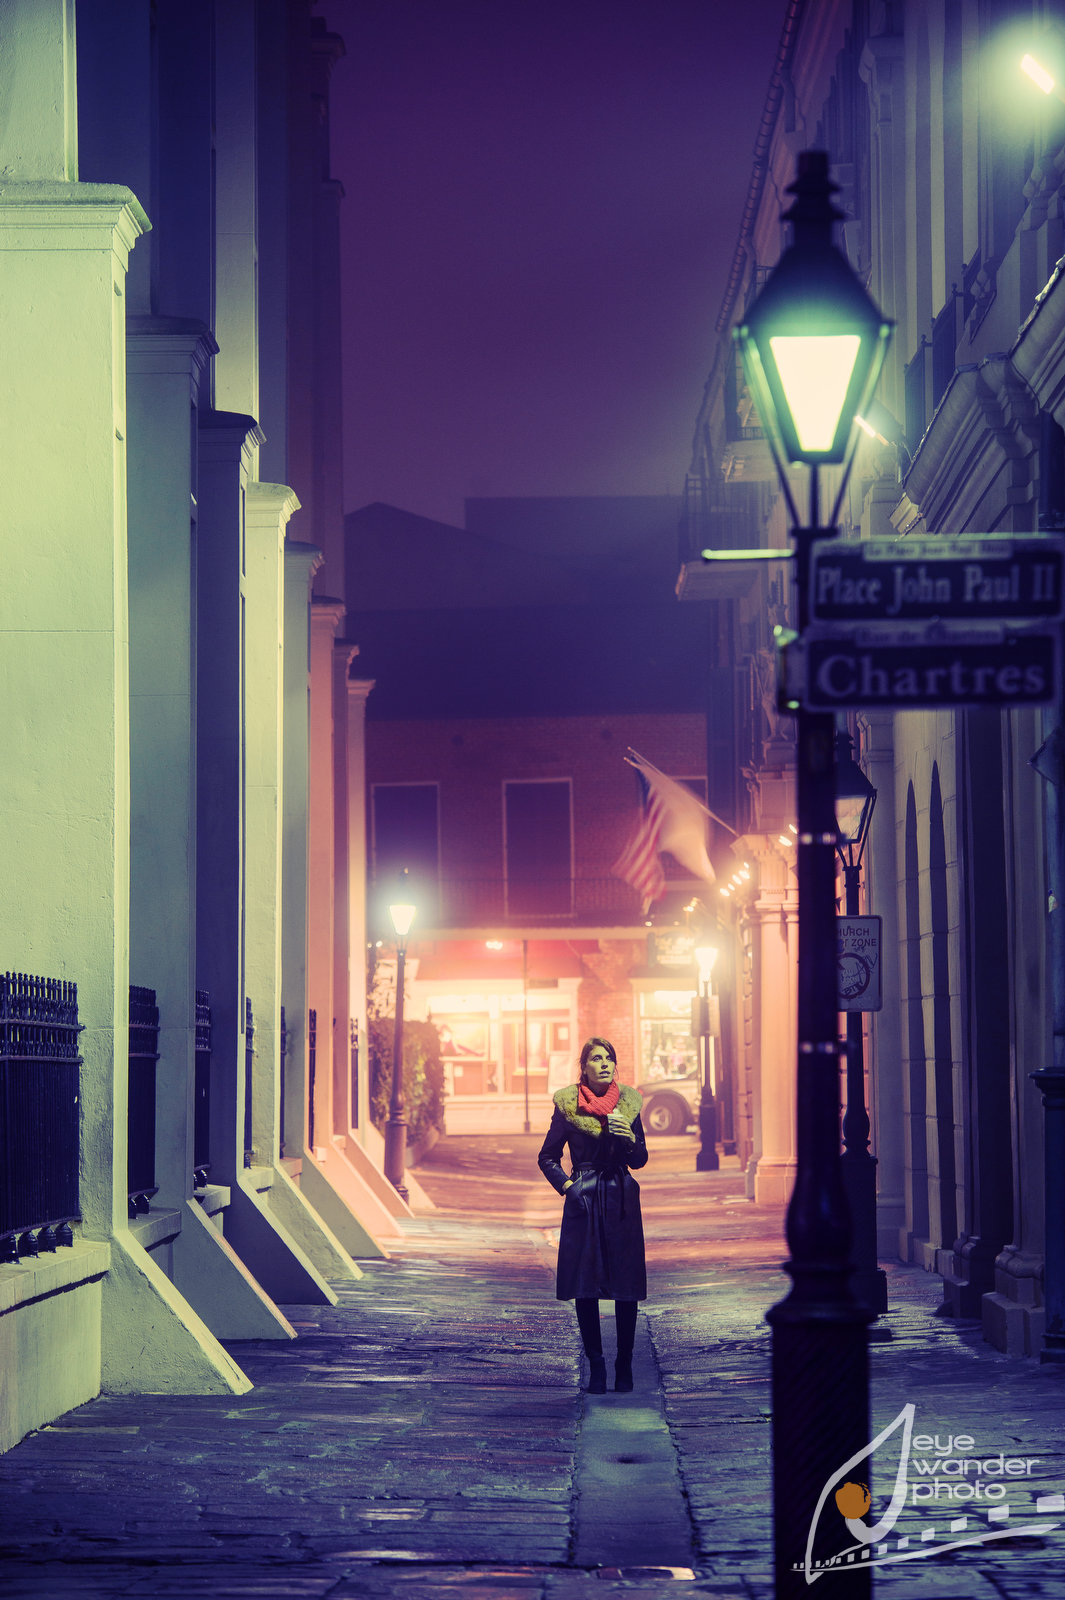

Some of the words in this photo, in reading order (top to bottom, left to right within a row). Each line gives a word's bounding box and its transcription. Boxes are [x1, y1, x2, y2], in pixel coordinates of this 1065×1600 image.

[817, 566, 882, 605] Place
[887, 565, 951, 615] John
[963, 564, 1020, 603] Paul
[1032, 563, 1055, 602] II
[817, 655, 1045, 698] Chartres
[839, 928, 870, 937] URCH
[851, 938, 877, 947] ZONE
